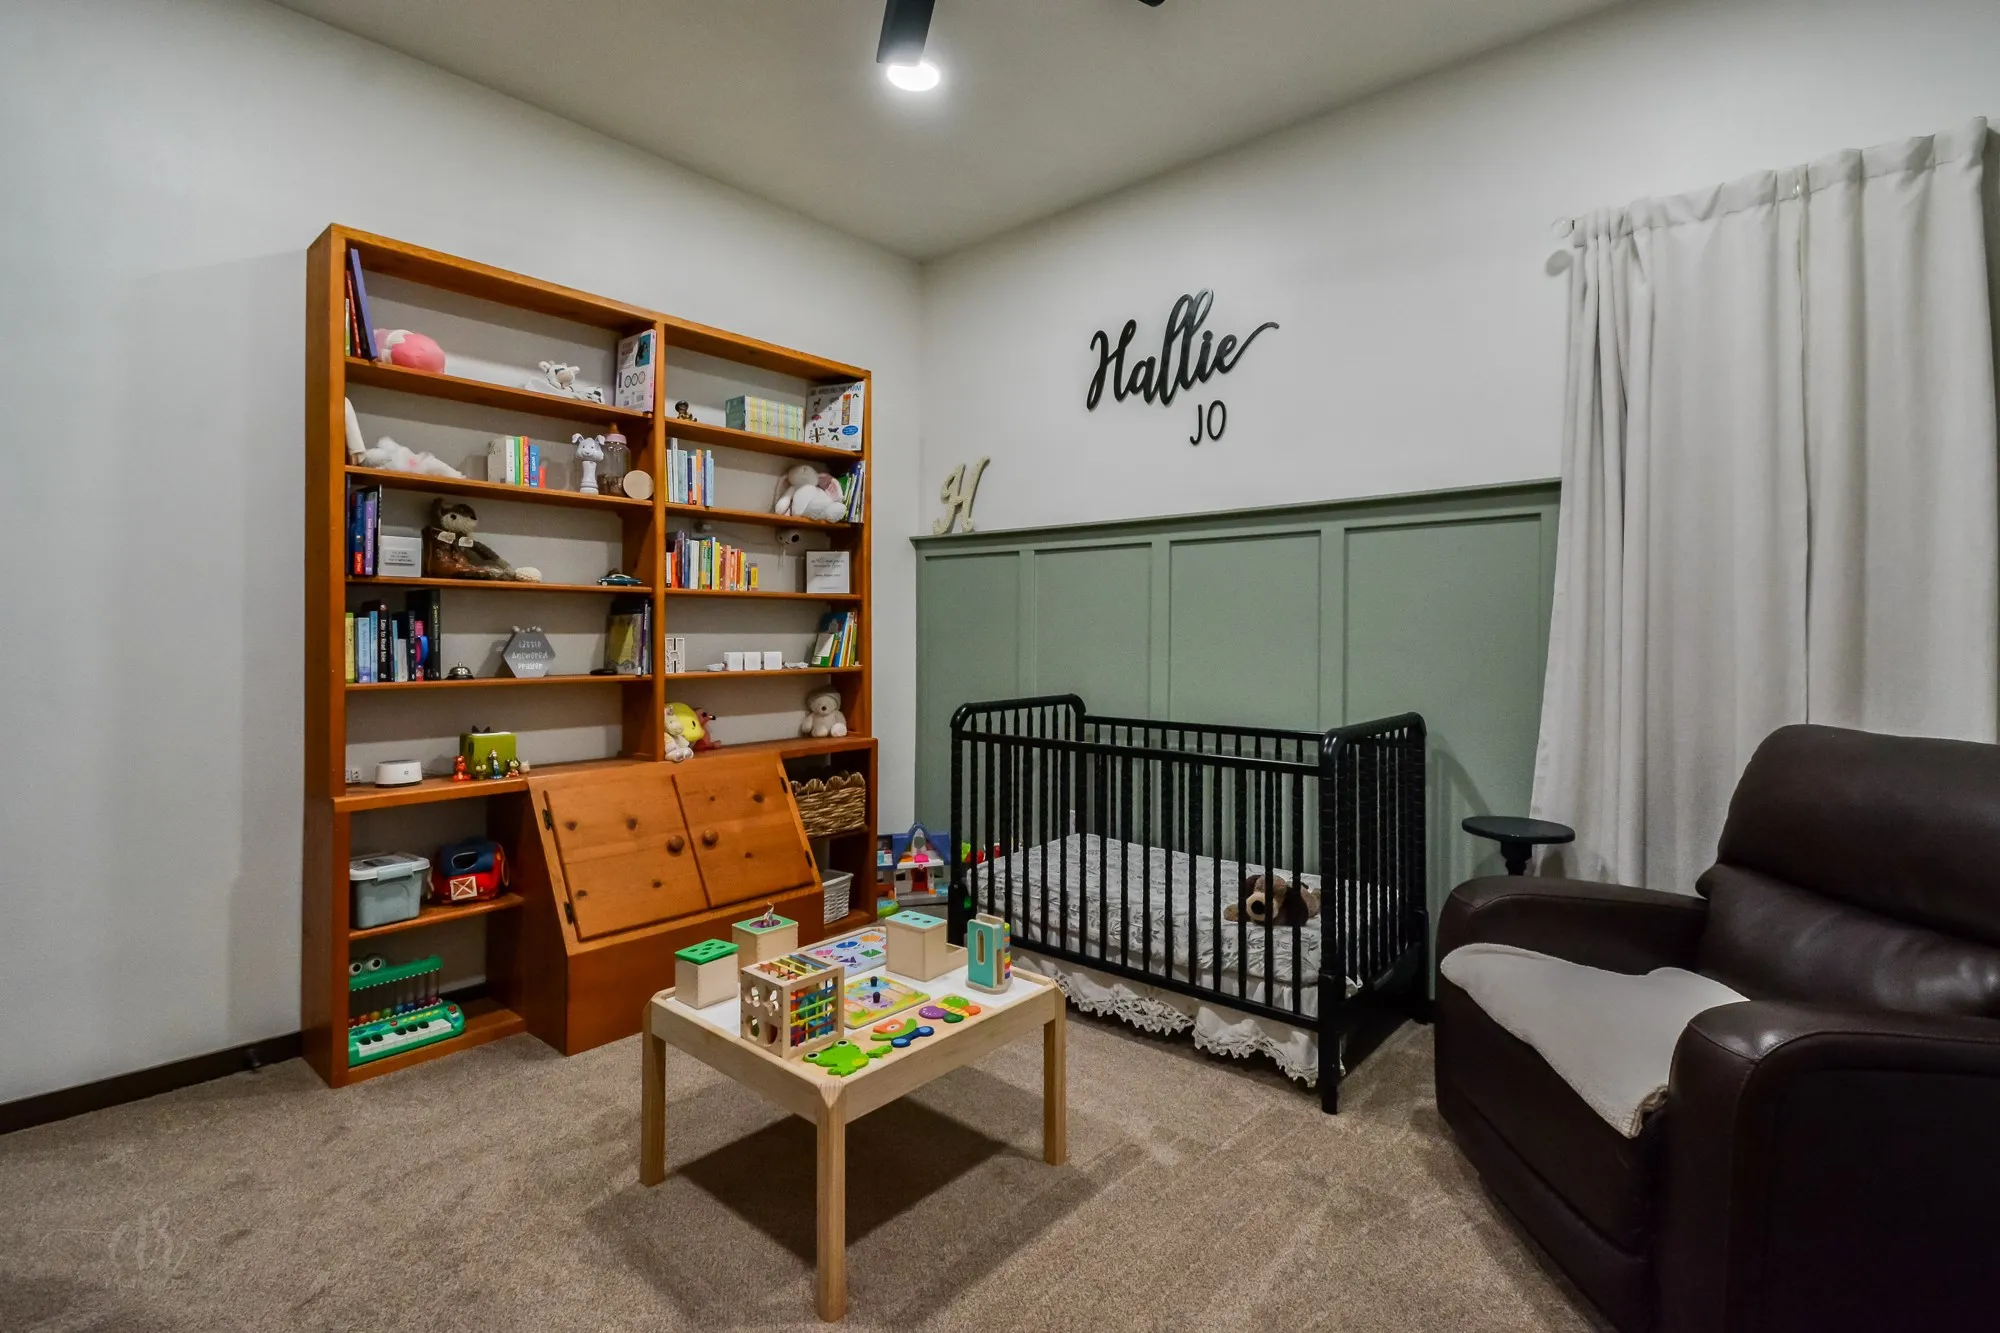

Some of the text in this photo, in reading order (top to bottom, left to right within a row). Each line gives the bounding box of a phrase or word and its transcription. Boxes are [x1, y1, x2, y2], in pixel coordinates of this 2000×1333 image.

[1087, 288, 1279, 411] Hallie
[1190, 400, 1226, 445] JO
[933, 456, 990, 535] H
